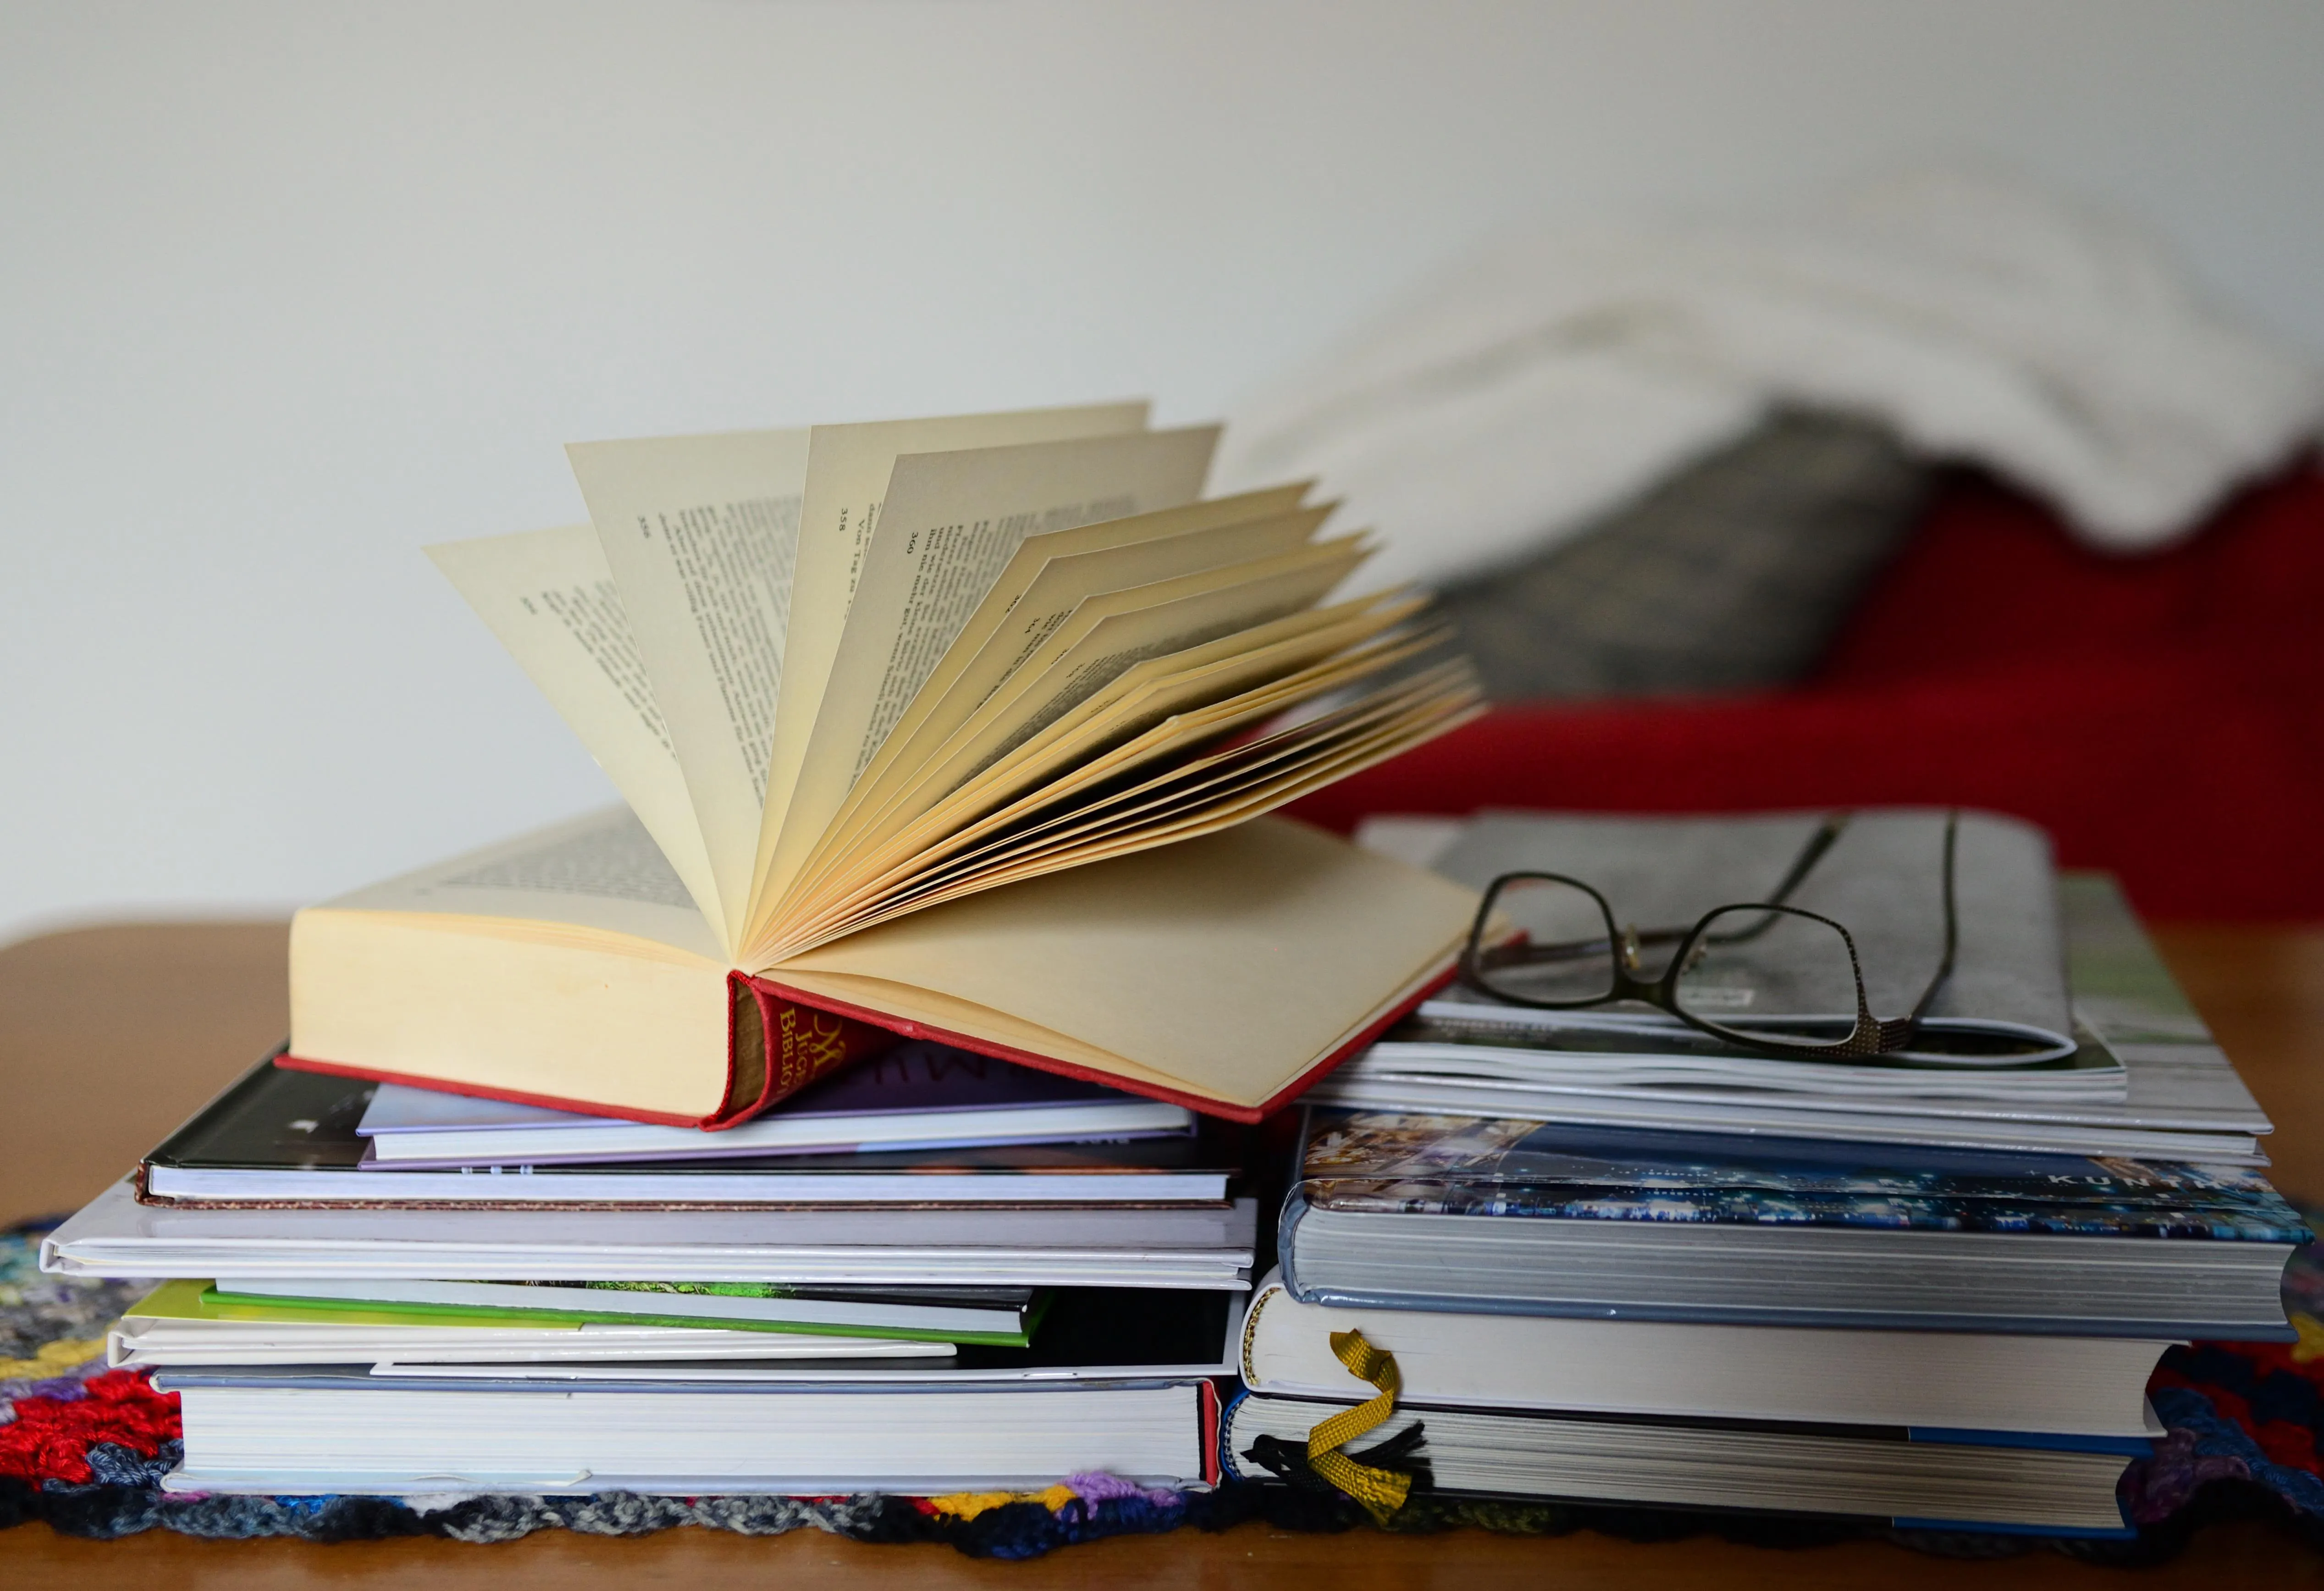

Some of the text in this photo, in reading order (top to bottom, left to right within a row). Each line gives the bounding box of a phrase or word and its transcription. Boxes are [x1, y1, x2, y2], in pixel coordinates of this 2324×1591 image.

[839, 508, 848, 531] 358
[856, 519, 865, 545] Von
[907, 532, 918, 554] 360
[925, 529, 937, 550] ihm
[934, 527, 944, 549] und
[851, 550, 861, 574] Tag
[919, 554, 927, 571] nie
[927, 554, 936, 573] wie
[909, 575, 921, 604] mehr
[1005, 594, 1022, 613] 362
[900, 608, 911, 630] gut,
[1025, 617, 1041, 634] 364
[2048, 1175, 2227, 1189] KUNTH
